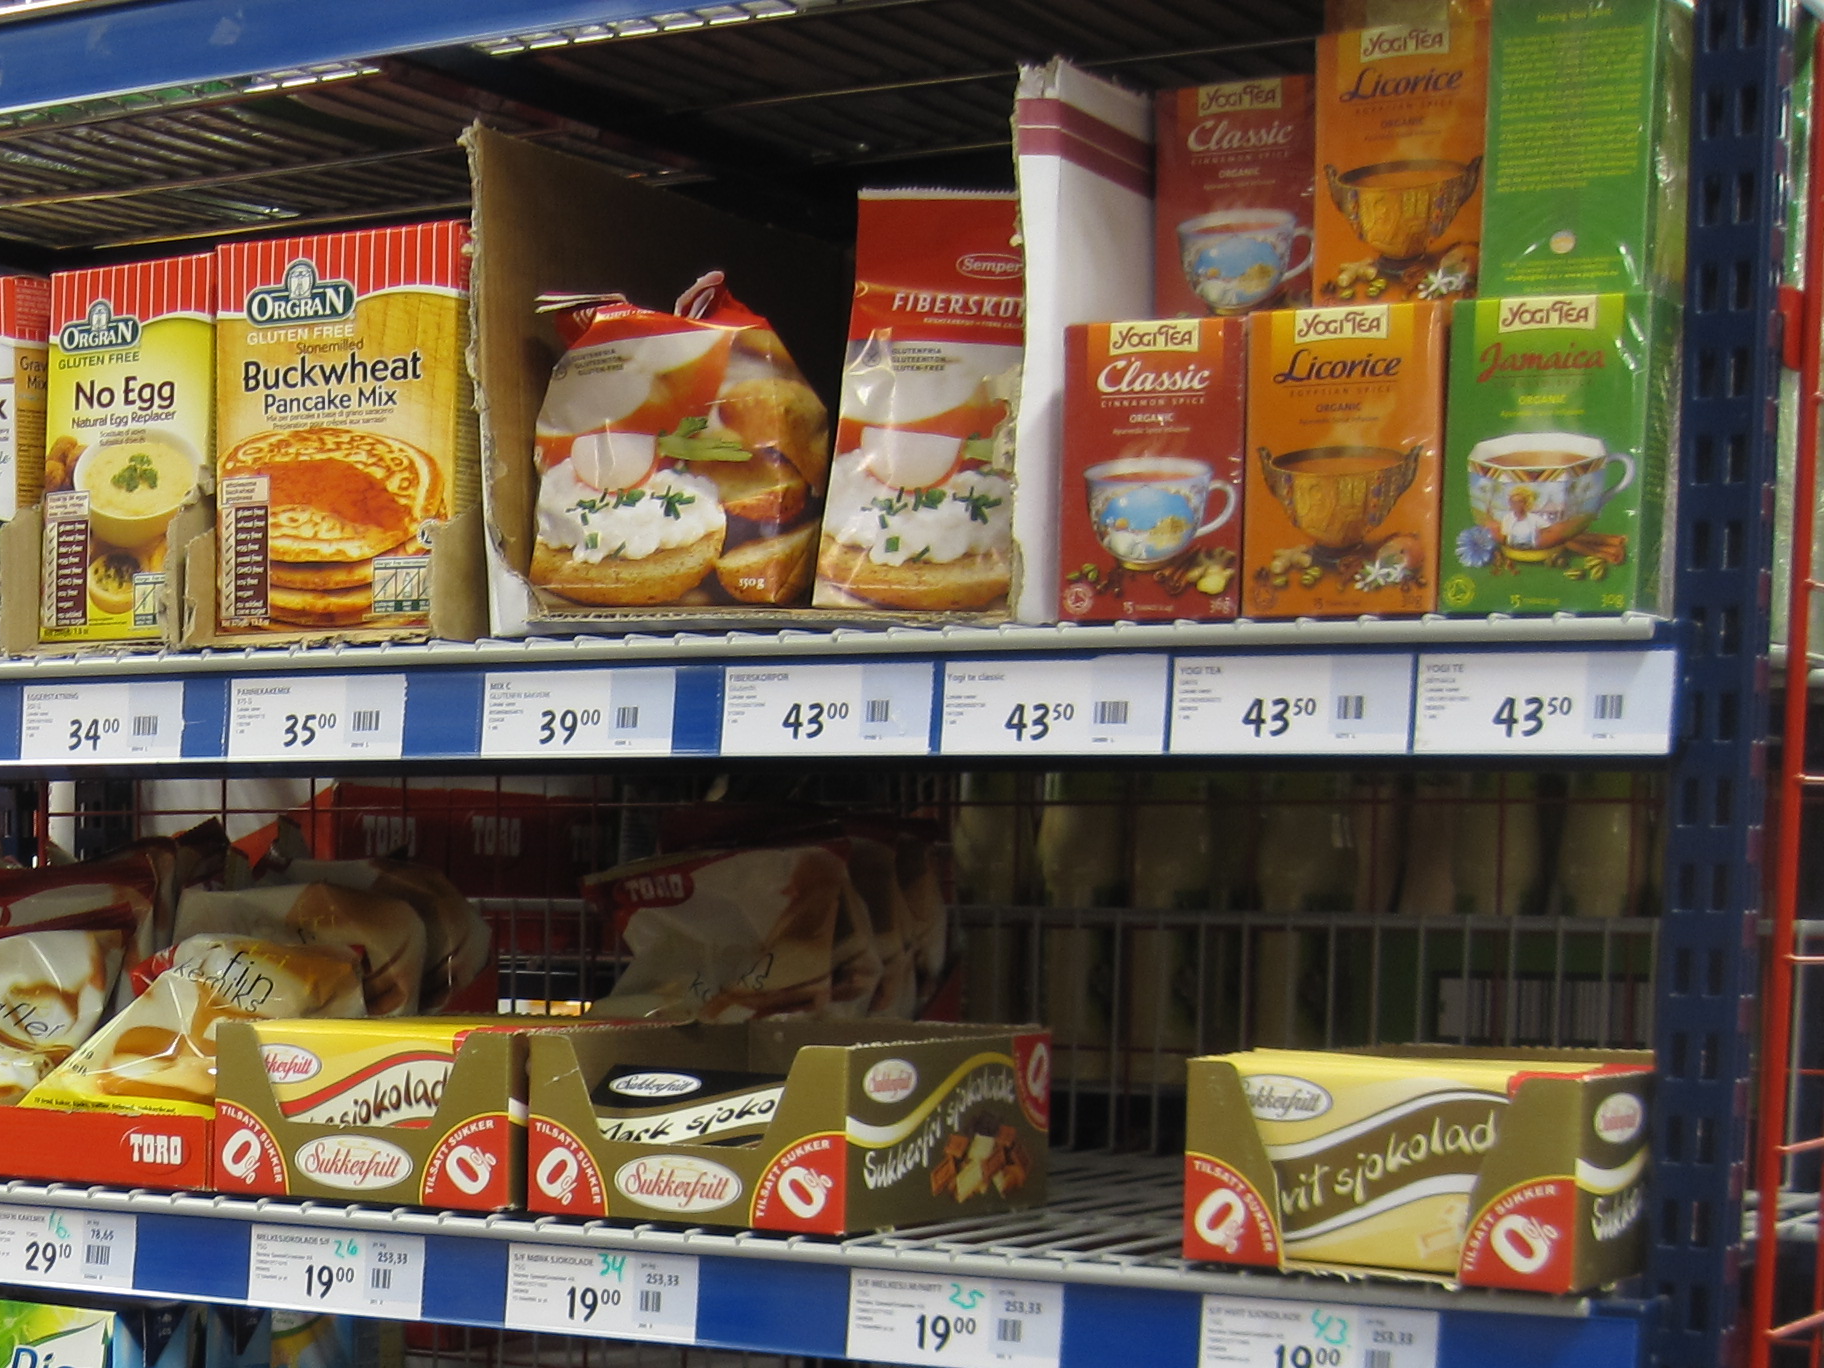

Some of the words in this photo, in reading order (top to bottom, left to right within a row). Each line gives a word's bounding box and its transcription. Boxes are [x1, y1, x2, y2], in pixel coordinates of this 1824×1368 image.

[1339, 66, 1466, 102] Licorice
[1186, 119, 1296, 154] Classic
[960, 257, 1022, 276] Semper
[250, 286, 346, 322] ORGRAN
[62, 321, 135, 352] ORGRAN
[247, 327, 309, 346] GLUTEN
[312, 324, 355, 340] FREE
[296, 337, 364, 354] Stonemilled
[58, 355, 104, 370] GLUTEN
[108, 351, 140, 366] FREE
[243, 349, 422, 394] Buckwheat
[1096, 358, 1211, 394] Classic
[1274, 348, 1402, 385] Licorice
[1477, 342, 1607, 384] Jamaica
[74, 379, 115, 412] No
[123, 375, 176, 412] Egg
[264, 390, 352, 415] Pancake
[357, 384, 398, 409] Mix
[71, 415, 107, 429] Natural
[109, 414, 128, 428] Egg
[131, 410, 177, 424] Replacer
[129, 1133, 183, 1166] TORO
[221, 1105, 262, 1135] TILSATT
[260, 1132, 283, 1185] SUKKER
[424, 1141, 451, 1196] TILSATT
[448, 1118, 495, 1146] SUKKER
[756, 1171, 783, 1219] TILSATT
[780, 1139, 831, 1168] SUKKER
[1462, 1208, 1498, 1274] TILSATT
[1495, 1184, 1557, 1218] SUKKER
